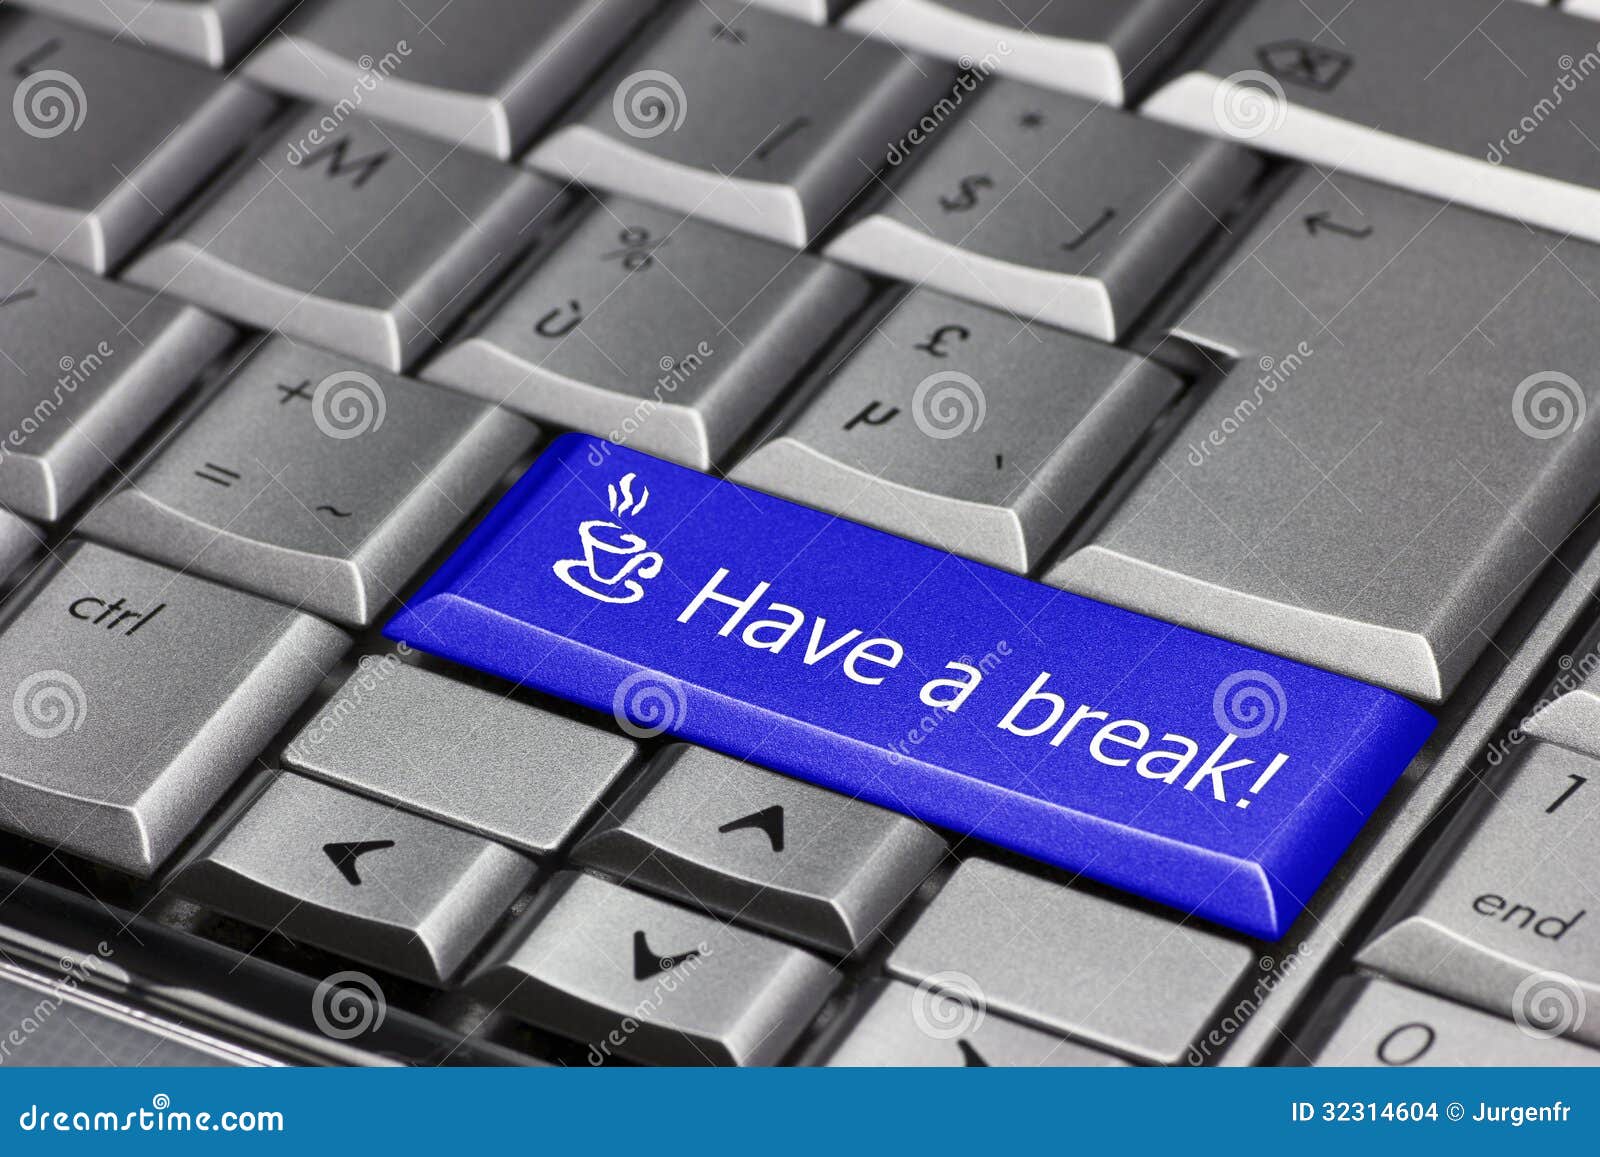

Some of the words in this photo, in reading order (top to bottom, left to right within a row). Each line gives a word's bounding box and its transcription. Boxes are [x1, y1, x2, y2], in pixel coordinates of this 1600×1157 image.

[300, 135, 393, 189] M
[914, 324, 970, 358] £
[195, 462, 241, 487] =
[316, 504, 352, 517] ~
[68, 594, 167, 637] ctrl
[676, 567, 904, 686] Have
[918, 658, 983, 713] a
[997, 670, 1290, 809] break!
[1545, 773, 1587, 814] 1
[1472, 893, 1586, 941] end
